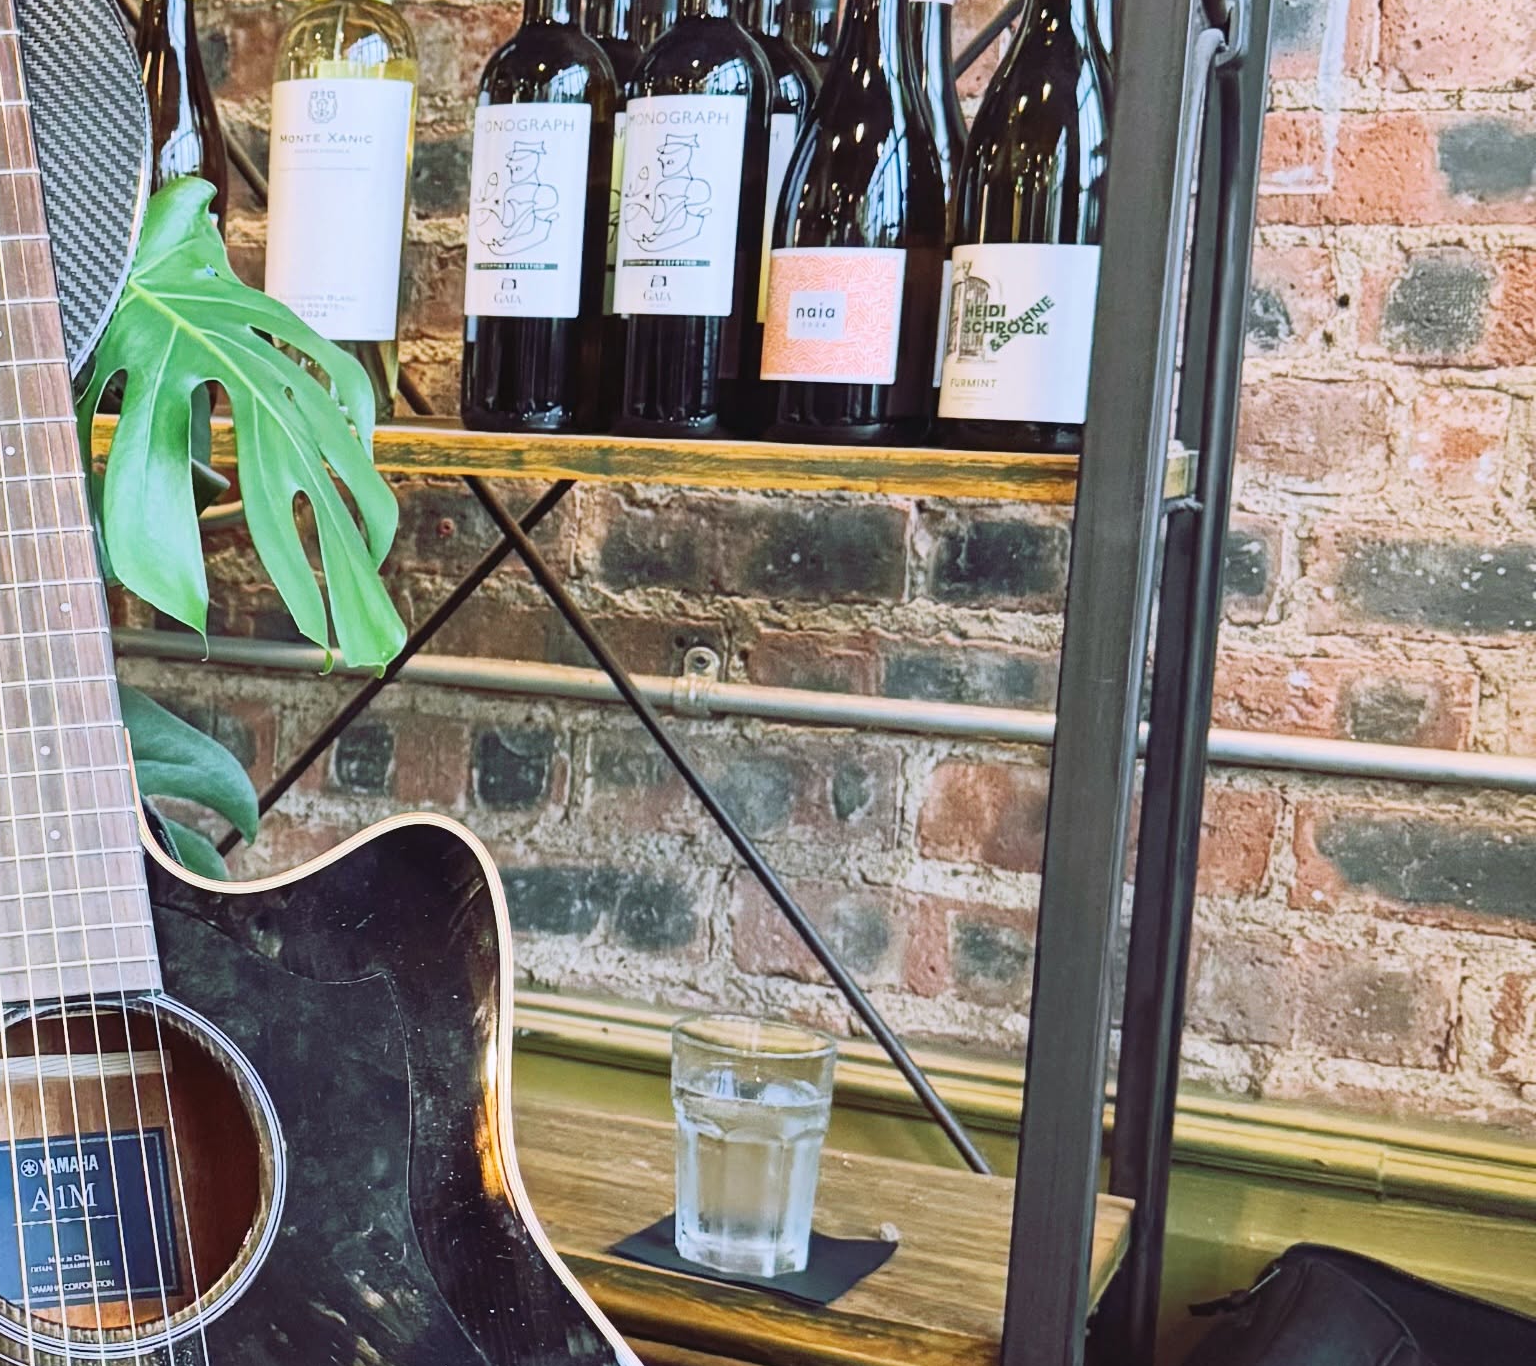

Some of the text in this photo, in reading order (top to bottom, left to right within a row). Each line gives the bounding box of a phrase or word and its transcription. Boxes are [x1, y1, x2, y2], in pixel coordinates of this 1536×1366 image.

[628, 110, 729, 126] MONOGRAPH
[280, 132, 374, 144] MONTE XANIC
[796, 302, 835, 319] naia
[965, 304, 1007, 319] HEIDI
[949, 378, 998, 389] FURMINT
[39, 1154, 99, 1176] YAMAHA
[30, 1182, 98, 1213] A1M
